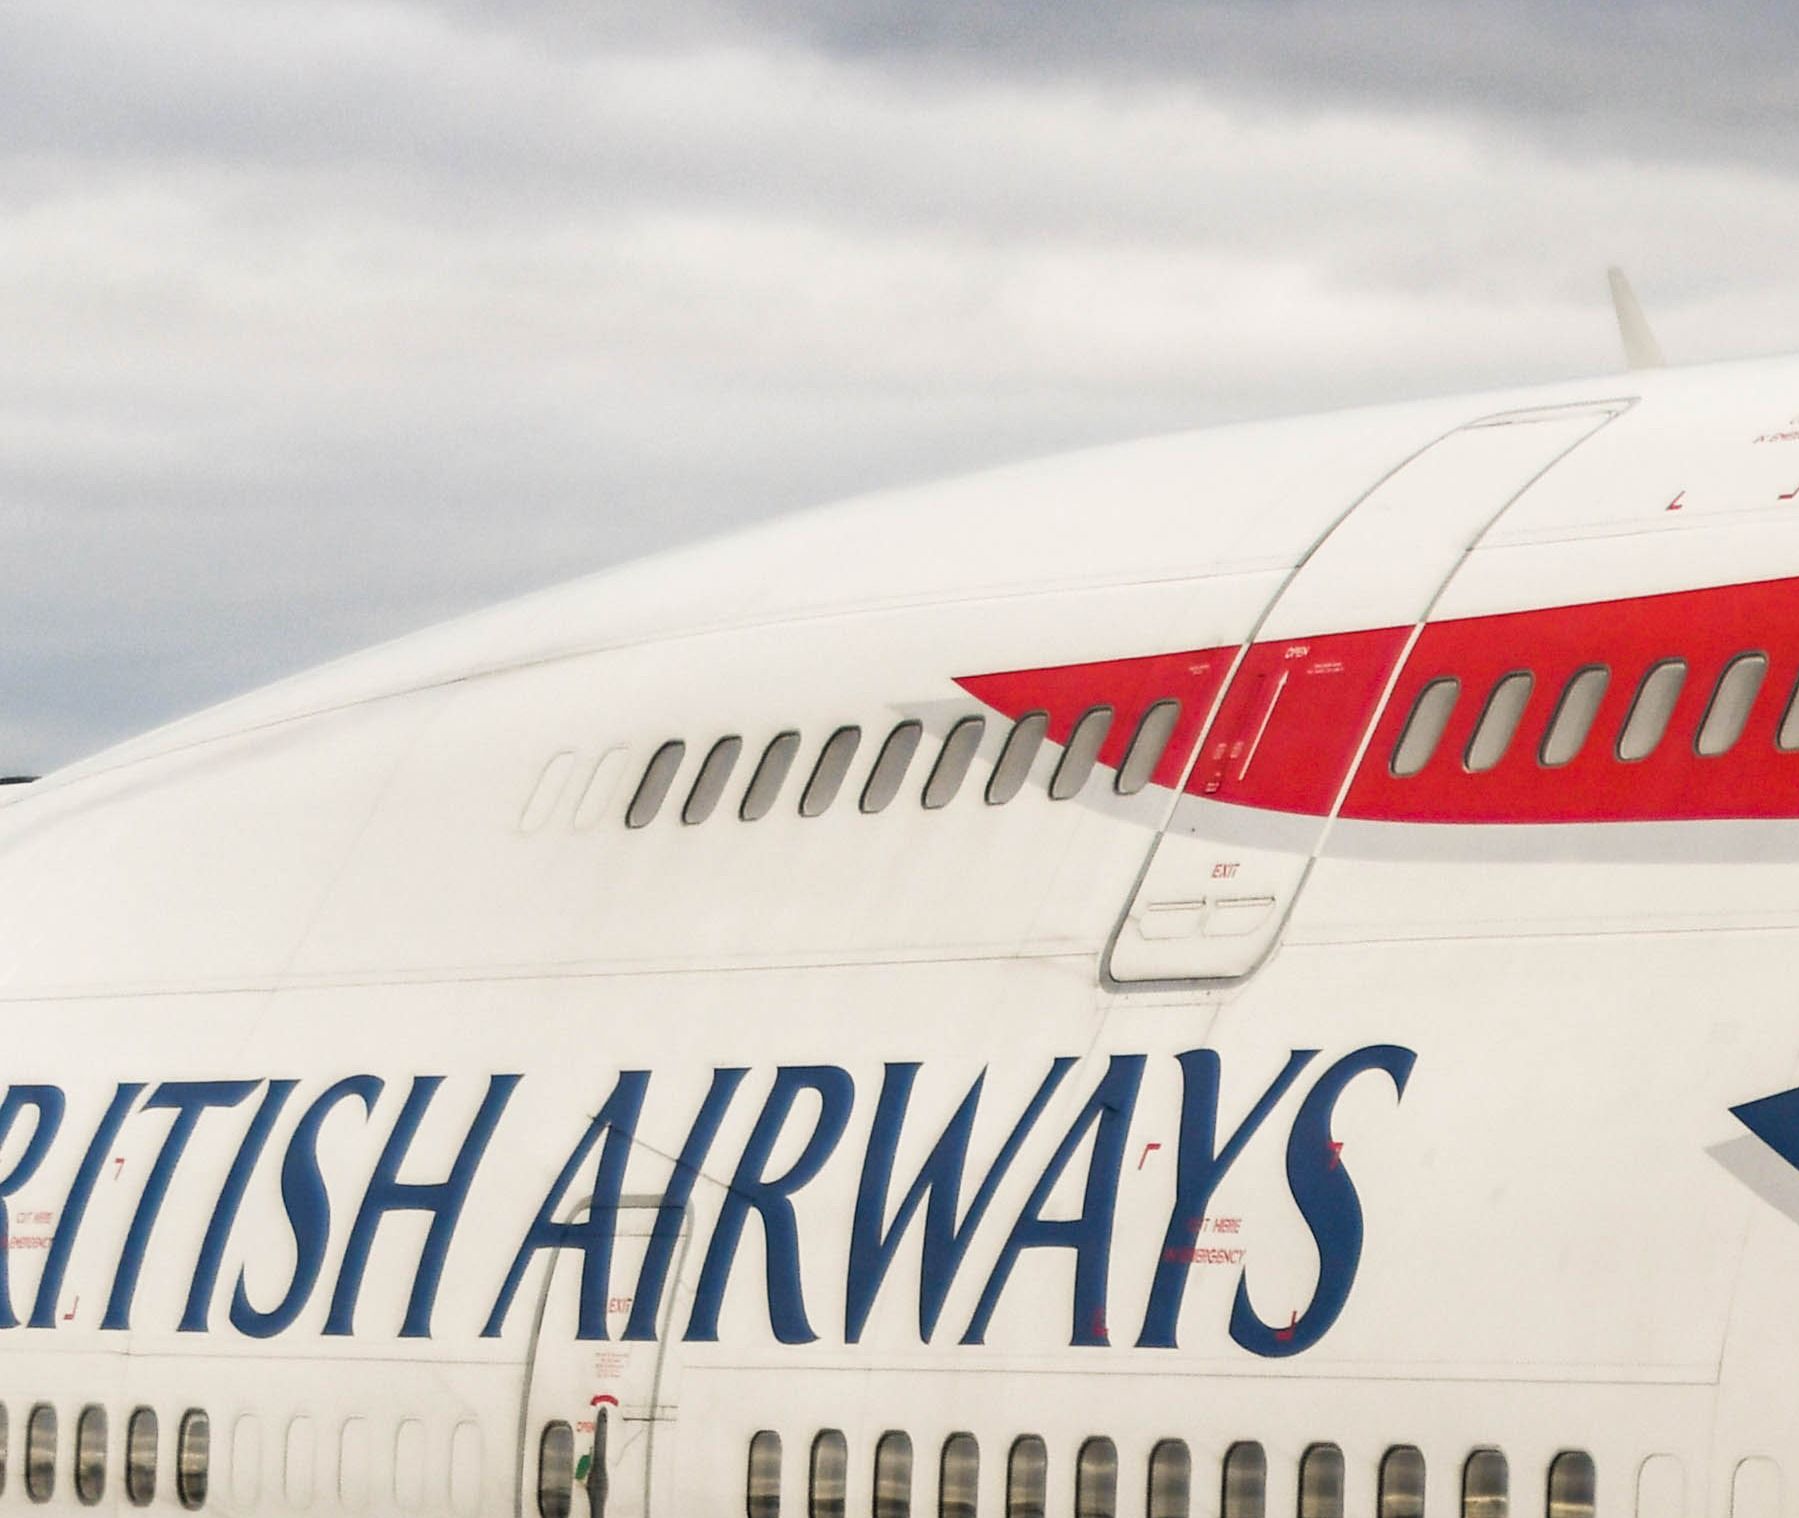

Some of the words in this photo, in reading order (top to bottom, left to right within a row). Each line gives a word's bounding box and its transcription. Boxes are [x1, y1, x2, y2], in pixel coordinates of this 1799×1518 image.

[1211, 863, 1241, 878] EXIT
[480, 1043, 1418, 1358] AIRWAYS
[608, 1298, 633, 1314] EXIT
